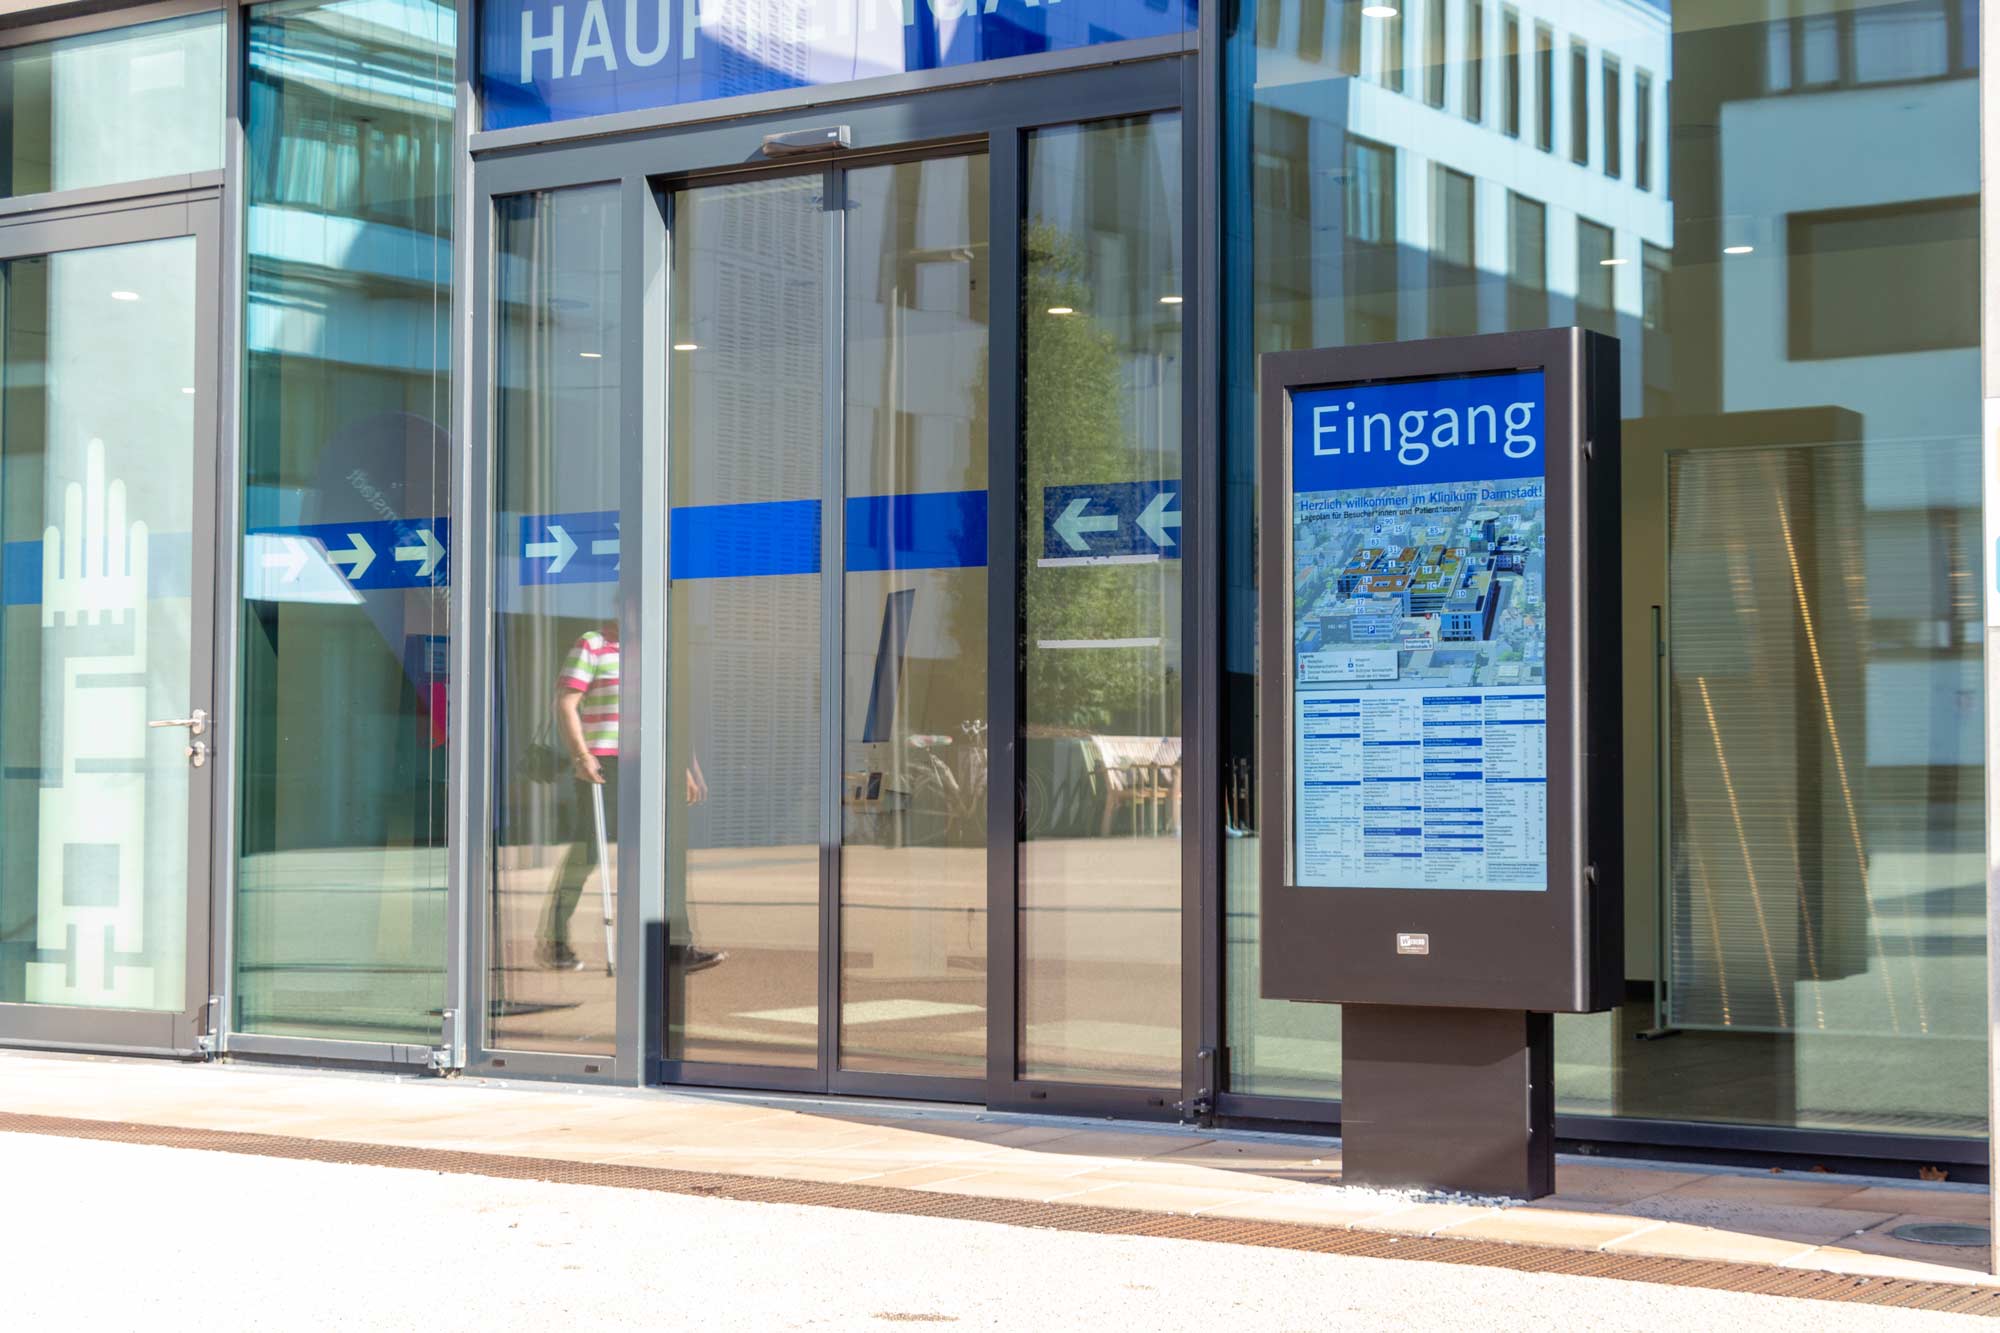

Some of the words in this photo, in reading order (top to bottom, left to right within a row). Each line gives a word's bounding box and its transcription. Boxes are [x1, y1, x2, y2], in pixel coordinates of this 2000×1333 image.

[1313, 401, 1537, 466] Eingang
[1300, 498, 1342, 511] Herzlich
[1345, 495, 1408, 508] willkommen
[1412, 494, 1425, 506] im
[1430, 490, 1477, 503] Klinikum
[1481, 486, 1542, 500] Darmstadt!
[1301, 513, 1331, 522] Lageplan
[1332, 511, 1341, 520] für
[1399, 508, 1412, 516] und
